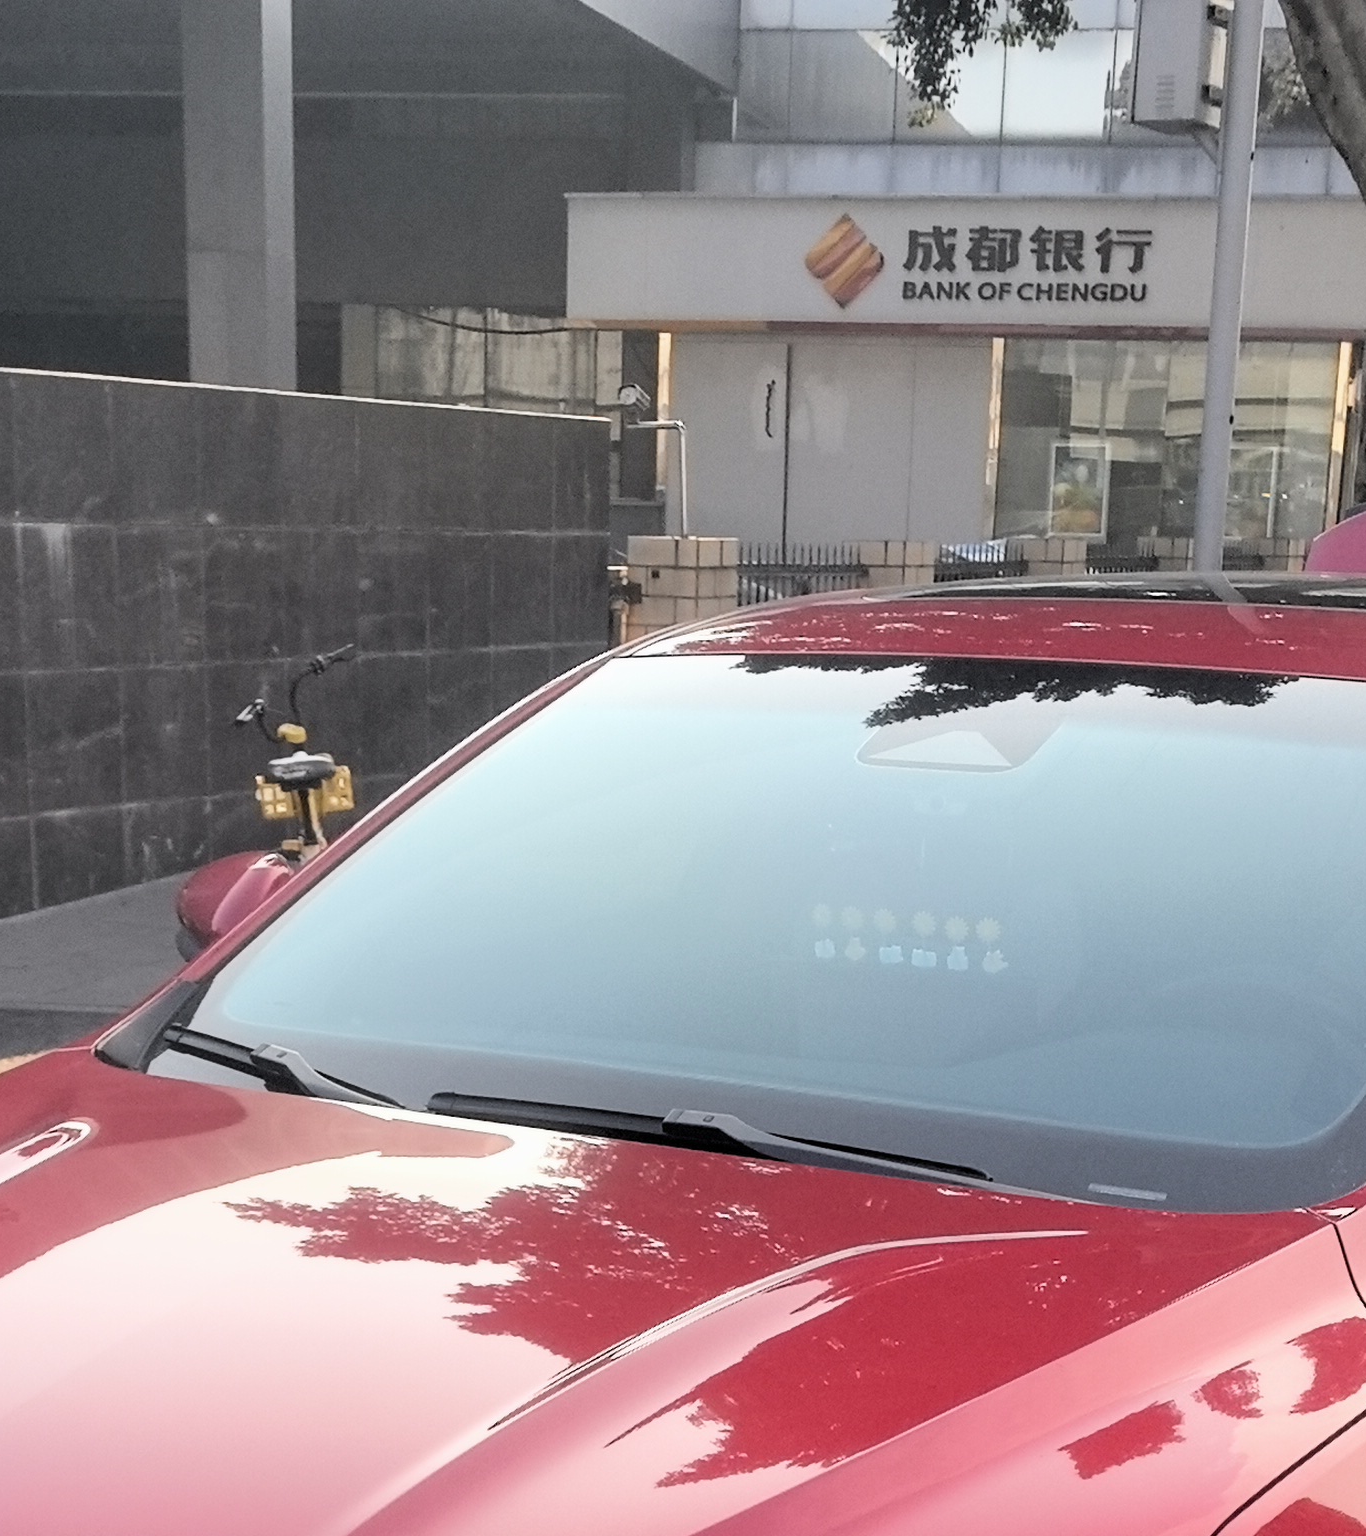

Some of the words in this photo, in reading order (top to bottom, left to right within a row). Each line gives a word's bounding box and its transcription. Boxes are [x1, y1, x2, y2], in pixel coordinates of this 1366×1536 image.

[902, 226, 1153, 273] 成都银行
[902, 281, 971, 301] BANK
[977, 282, 1012, 301] OF
[1017, 282, 1147, 302] CHENGDU
